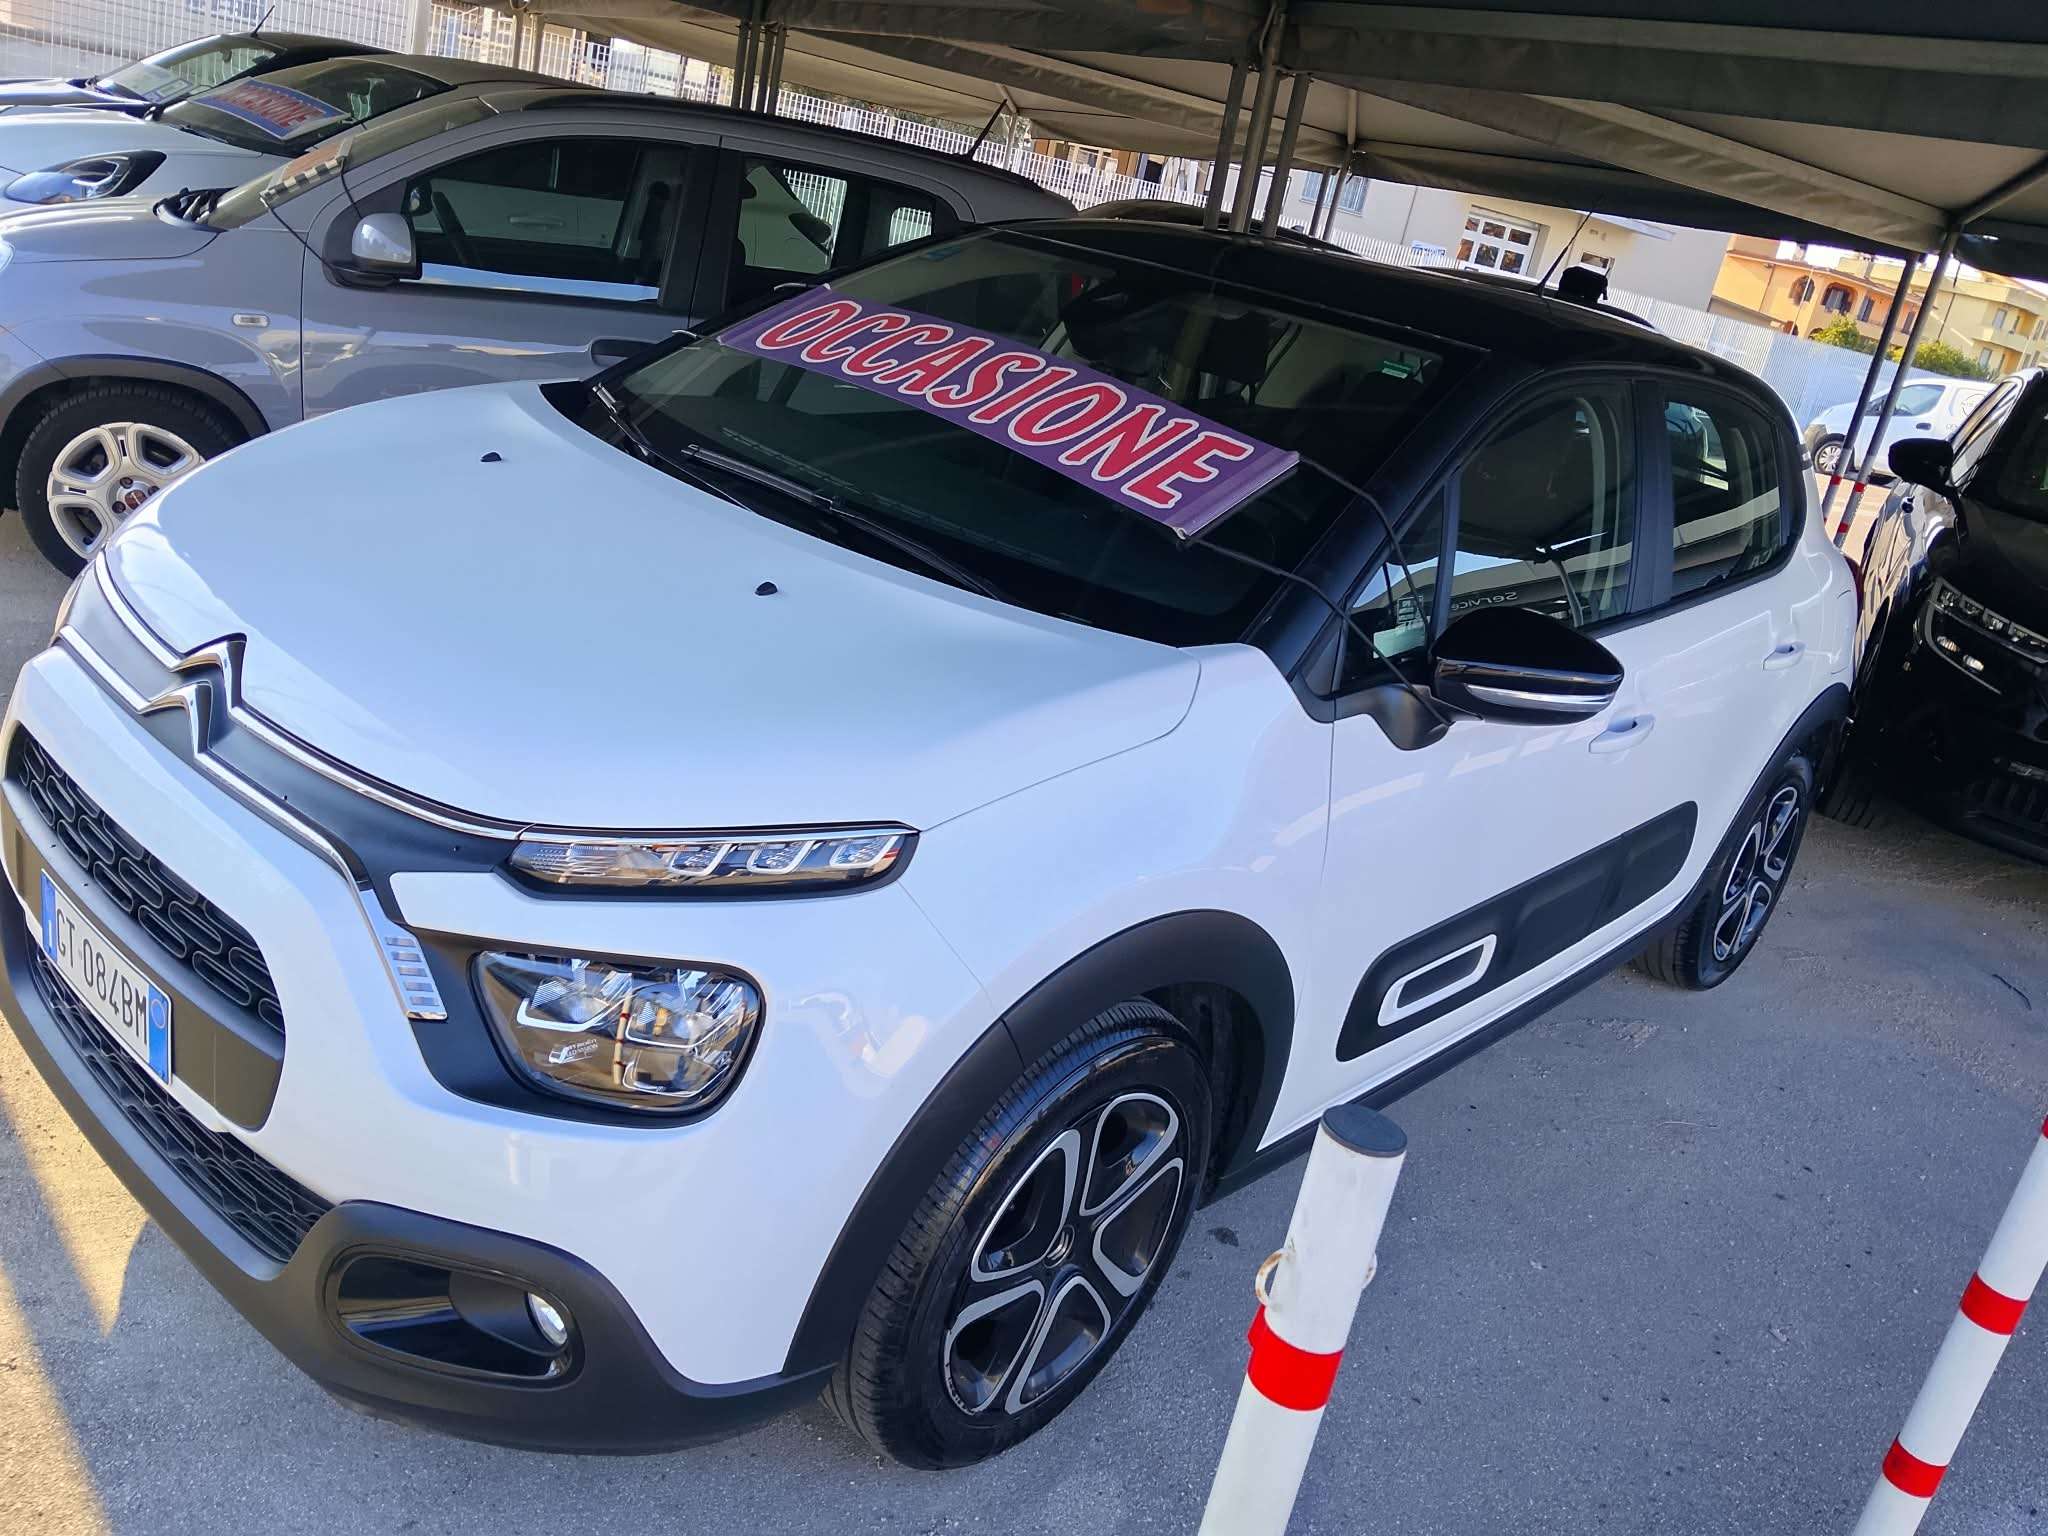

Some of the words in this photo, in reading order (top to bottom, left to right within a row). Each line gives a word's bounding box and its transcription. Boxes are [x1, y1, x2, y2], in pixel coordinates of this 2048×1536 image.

[212, 84, 326, 128] ASIONE
[755, 299, 1255, 509] OCCASIONE
[56, 908, 76, 969] GT
[82, 938, 148, 1046] 084BM
